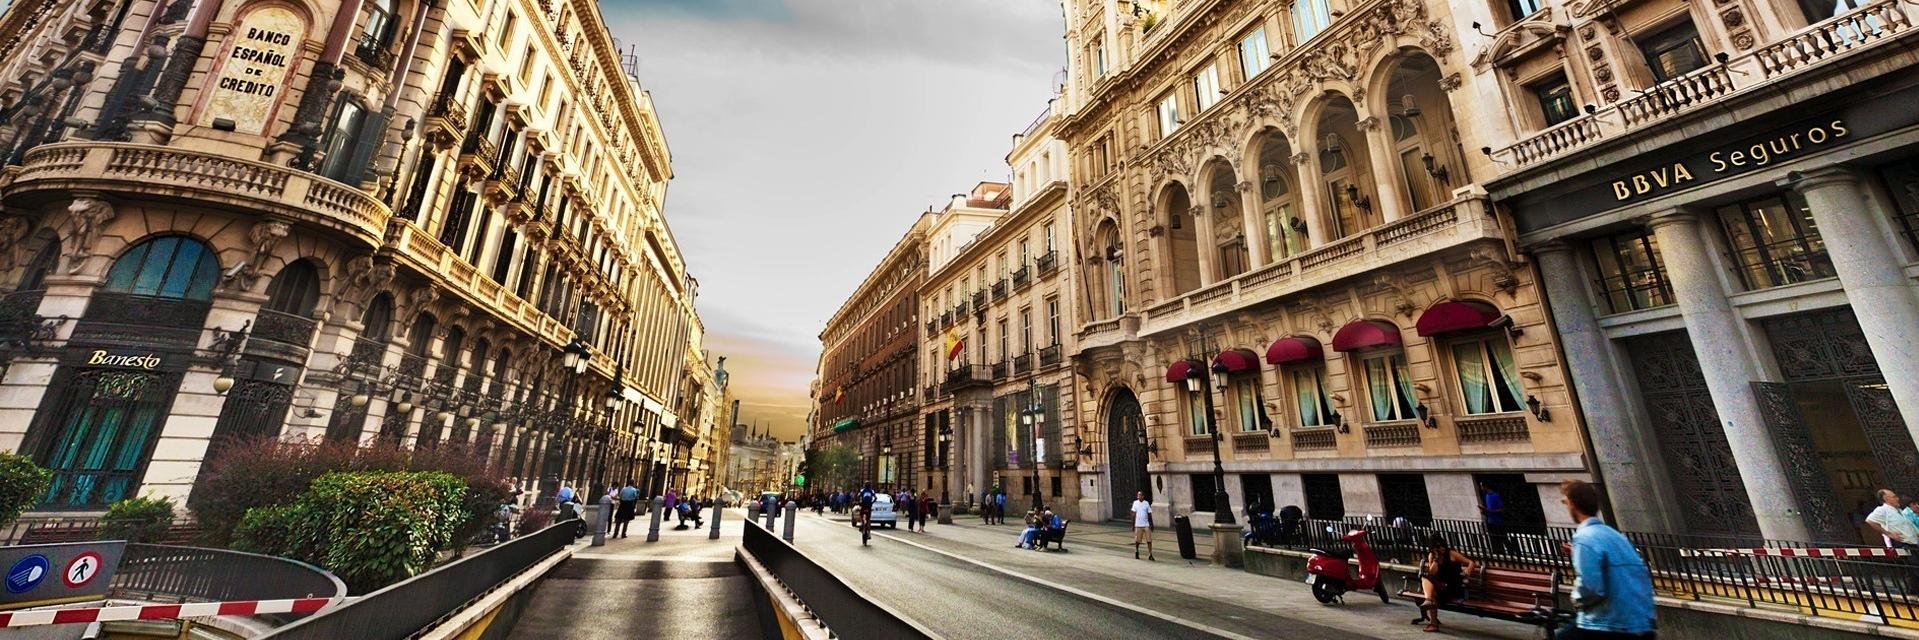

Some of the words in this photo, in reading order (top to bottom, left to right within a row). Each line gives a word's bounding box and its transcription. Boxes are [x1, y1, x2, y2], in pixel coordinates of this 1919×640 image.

[248, 28, 290, 46] BANCO
[232, 46, 286, 67] ESPAÑOL
[245, 67, 263, 76] DE
[220, 77, 275, 97] CREDITO
[1612, 163, 1693, 201] BBVA
[1710, 120, 1848, 172] Seguros
[88, 350, 161, 370] Banesto
